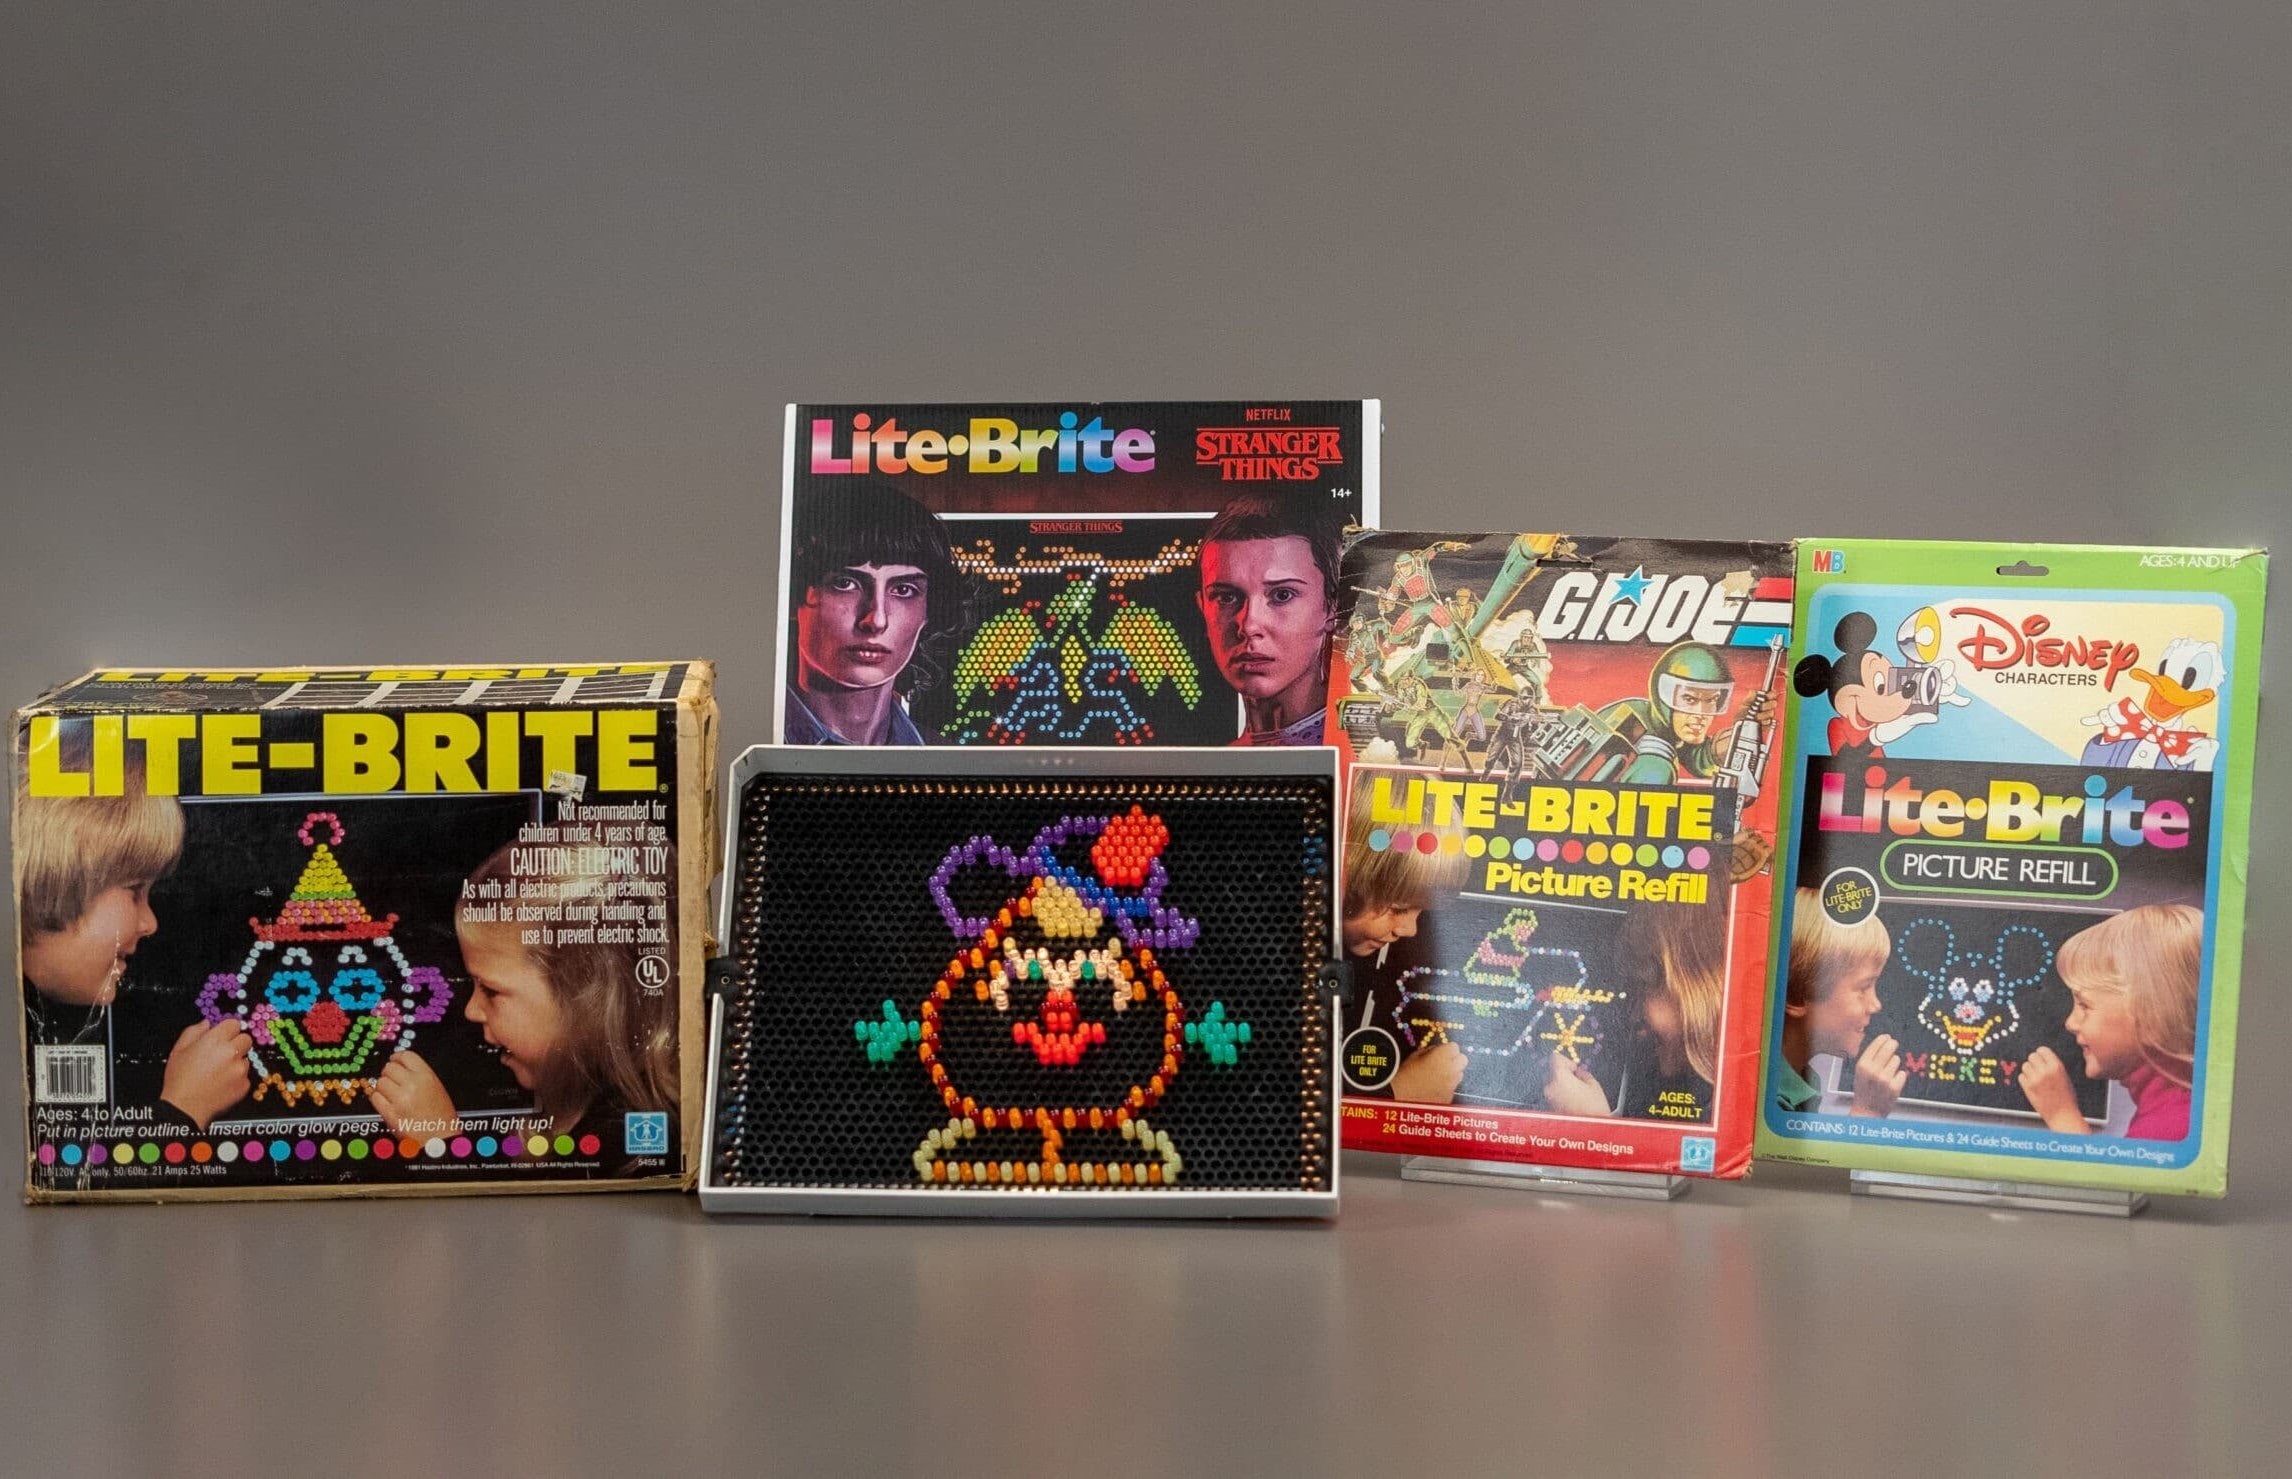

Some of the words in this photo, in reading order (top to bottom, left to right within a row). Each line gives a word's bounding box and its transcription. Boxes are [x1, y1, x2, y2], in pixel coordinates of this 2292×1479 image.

[1246, 409, 1291, 422] NETFLIX
[1196, 431, 1343, 460] STRANGER
[1218, 458, 1320, 481] THINGS
[1330, 488, 1352, 498] 14+
[1030, 522, 1081, 533] STRANGER
[1085, 522, 1123, 533] THINGS
[1812, 550, 1845, 573] MB
[2140, 555, 2176, 567] AGES:
[2187, 556, 2219, 568] AND
[1995, 672, 2097, 686] CHARACTERS
[28, 710, 658, 797] LITE-BRITE
[558, 801, 575, 820] Not
[578, 801, 649, 820] recommended
[652, 801, 667, 820] for
[1371, 777, 1714, 841] LITE-BRITE
[518, 822, 558, 842] children
[563, 823, 591, 842] under
[594, 823, 602, 841] 4
[605, 826, 632, 845] years
[635, 822, 645, 842] of
[647, 826, 668, 845] age.
[510, 847, 574, 876] CAUTION:
[579, 847, 639, 875] ELECTRIC
[643, 847, 668, 875] TOY
[1903, 853, 2010, 880] PICTURE
[2019, 859, 2096, 886] REFILL
[462, 879, 475, 899] As
[478, 879, 501, 899] with
[504, 879, 516, 898] all
[519, 879, 557, 898] electric
[608, 878, 666, 900] precautions
[1485, 861, 1612, 899] Picture
[1619, 869, 1708, 903] Refill
[1836, 881, 1857, 893] FOR
[463, 902, 496, 922] should
[501, 902, 513, 921] be
[516, 901, 561, 921] observed
[565, 901, 598, 924] during
[601, 900, 645, 924] handling
[647, 900, 666, 920] and
[1837, 899, 1863, 913] ONLY
[521, 930, 539, 945] use
[543, 927, 553, 944] to
[557, 926, 594, 947] prevent
[597, 924, 634, 943] electric
[637, 923, 670, 943] shock.
[638, 947, 666, 955] LISTED
[642, 959, 662, 983] UL
[643, 989, 664, 997] 740A
[1351, 1055, 1365, 1065] LITE
[1367, 1056, 1387, 1066] BRITE
[1363, 1045, 1376, 1054] FOR
[1359, 1067, 1377, 1077] ONLY
[1905, 1052, 2018, 1085] MICKEY
[1659, 1092, 1695, 1104] AGES:
[37, 1107, 78, 1121] Ages:
[81, 1108, 90, 1120] 4
[94, 1107, 110, 1120] to
[113, 1105, 153, 1120] Adult
[1341, 1107, 1378, 1119] TAINS:
[1384, 1110, 1398, 1121] 12
[1400, 1111, 1450, 1125] Lite-Brite
[1452, 1115, 1499, 1130] Pictures
[37, 1124, 61, 1138] Put
[63, 1124, 77, 1138] in
[79, 1124, 134, 1141] picture
[256, 1120, 294, 1135] color
[298, 1120, 336, 1137] glow
[450, 1117, 489, 1131] them
[492, 1116, 525, 1134] light
[528, 1115, 554, 1133] up!
[1382, 1123, 1396, 1134] 24
[1398, 1124, 1432, 1136] Guide
[1434, 1127, 1472, 1140] Sheets
[1475, 1131, 1487, 1141] to
[1489, 1132, 1526, 1145] Create
[1530, 1135, 1556, 1148] Your
[1558, 1138, 1584, 1151] Own
[1587, 1142, 1634, 1155] Designs
[1786, 1119, 1846, 1134] CONTAINS:
[1849, 1125, 1859, 1136] 12
[1861, 1126, 1905, 1140] Lite-Brite
[1906, 1129, 1945, 1143] Pictures
[1946, 1133, 1954, 1143] &
[1957, 1134, 1969, 1145] 24
[1971, 1134, 2000, 1148] Guide
[2001, 1137, 2032, 1150] Sheets
[2036, 1140, 2048, 1151] to
[2049, 1141, 2082, 1154] Create
[2084, 1144, 2105, 1156] Your
[2108, 1146, 2135, 1158] Own
[2136, 1148, 2175, 1163] Designs
[165, 1165, 188, 1176] Amps
[190, 1165, 201, 1175] 25
[203, 1165, 227, 1175] Watts
